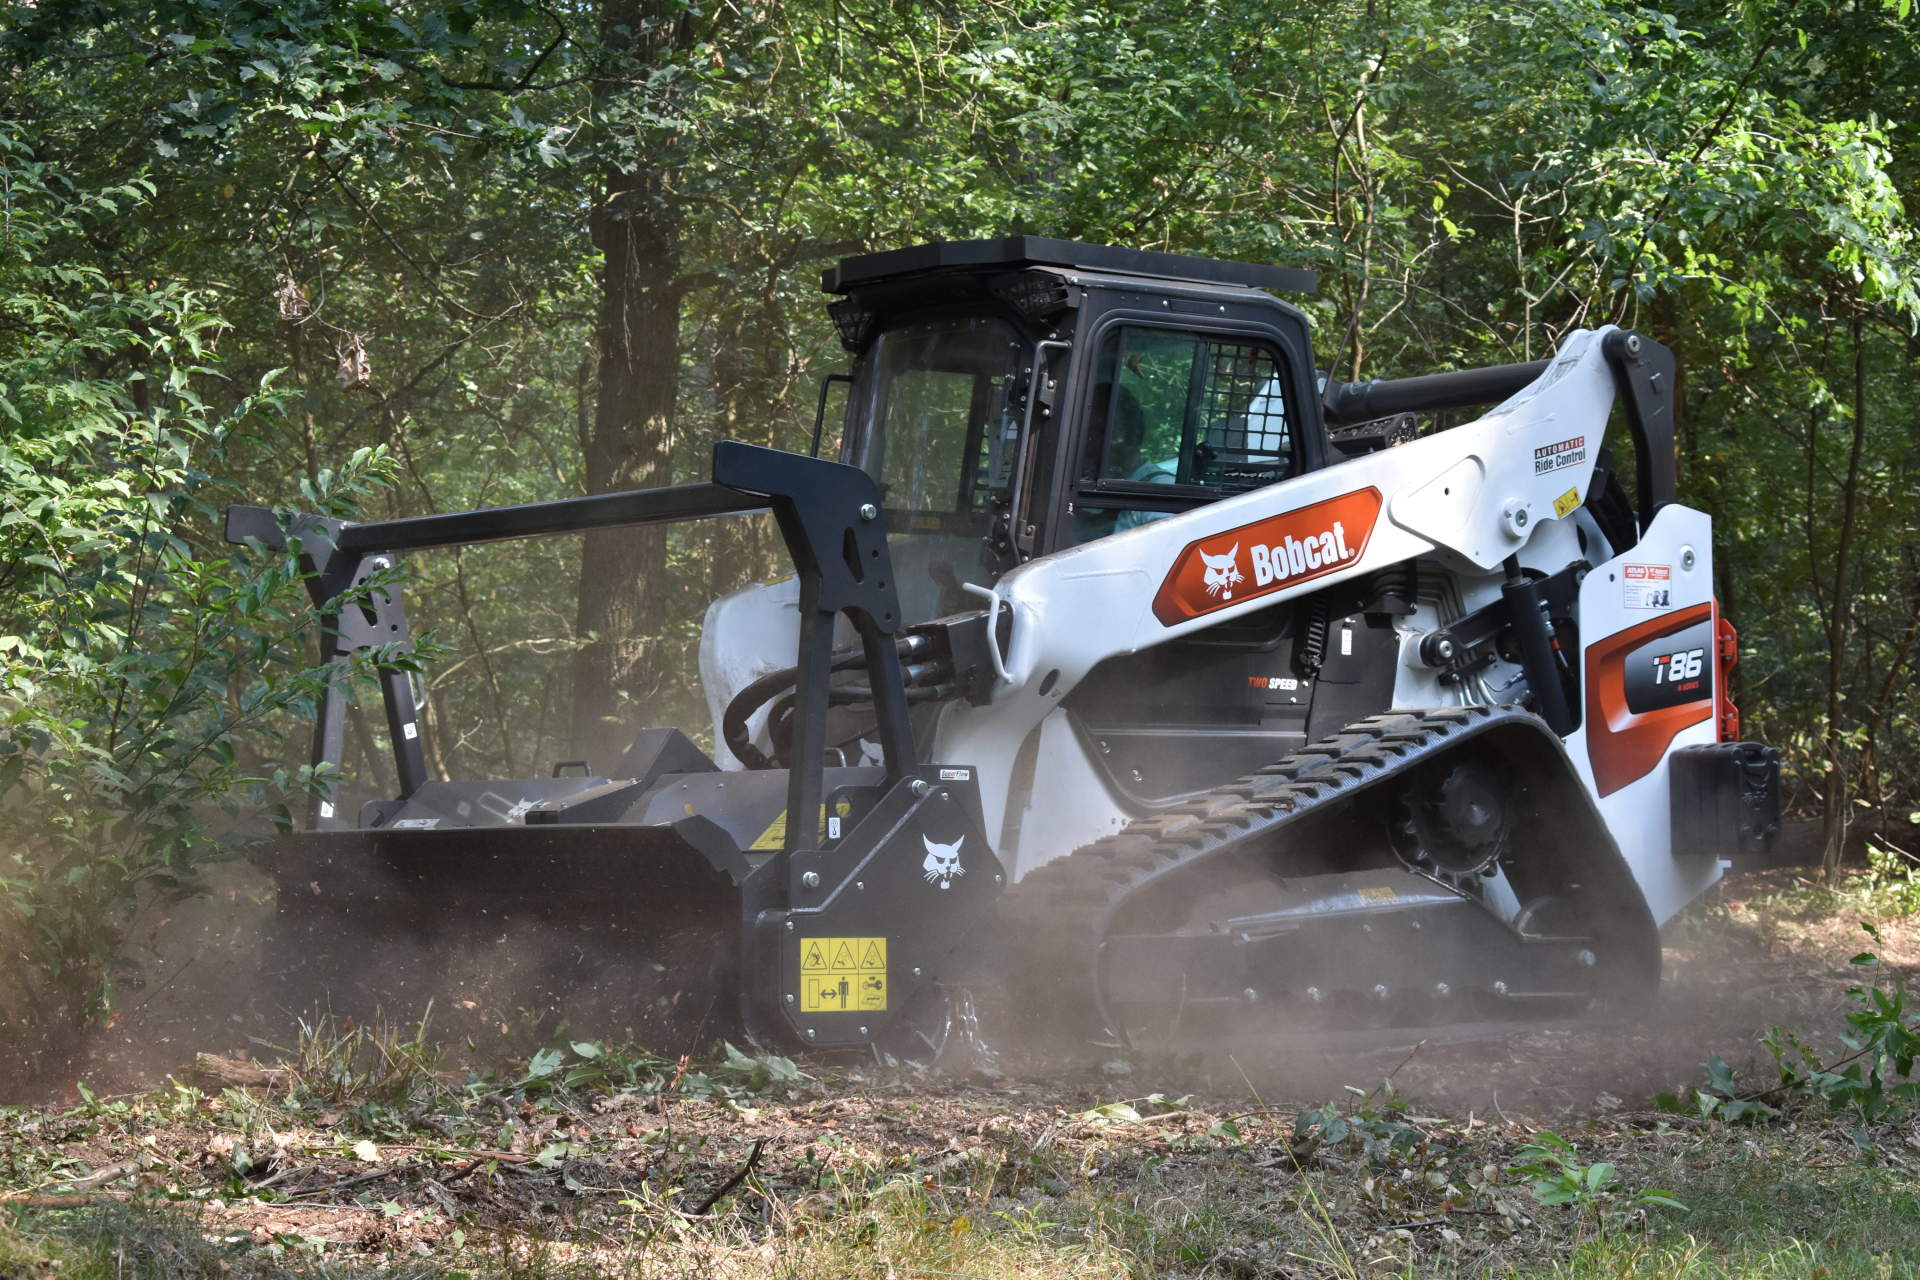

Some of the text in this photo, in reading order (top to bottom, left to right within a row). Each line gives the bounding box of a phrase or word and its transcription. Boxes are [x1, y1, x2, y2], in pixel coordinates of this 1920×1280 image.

[1535, 447, 1586, 473] Ride Control
[1536, 437, 1584, 459] AUTOMATIC
[1250, 521, 1349, 587] Bobcat
[1653, 648, 1704, 685] T86
[1248, 676, 1298, 690] TWO SPEED
[1677, 680, 1700, 692] R-SERIES
